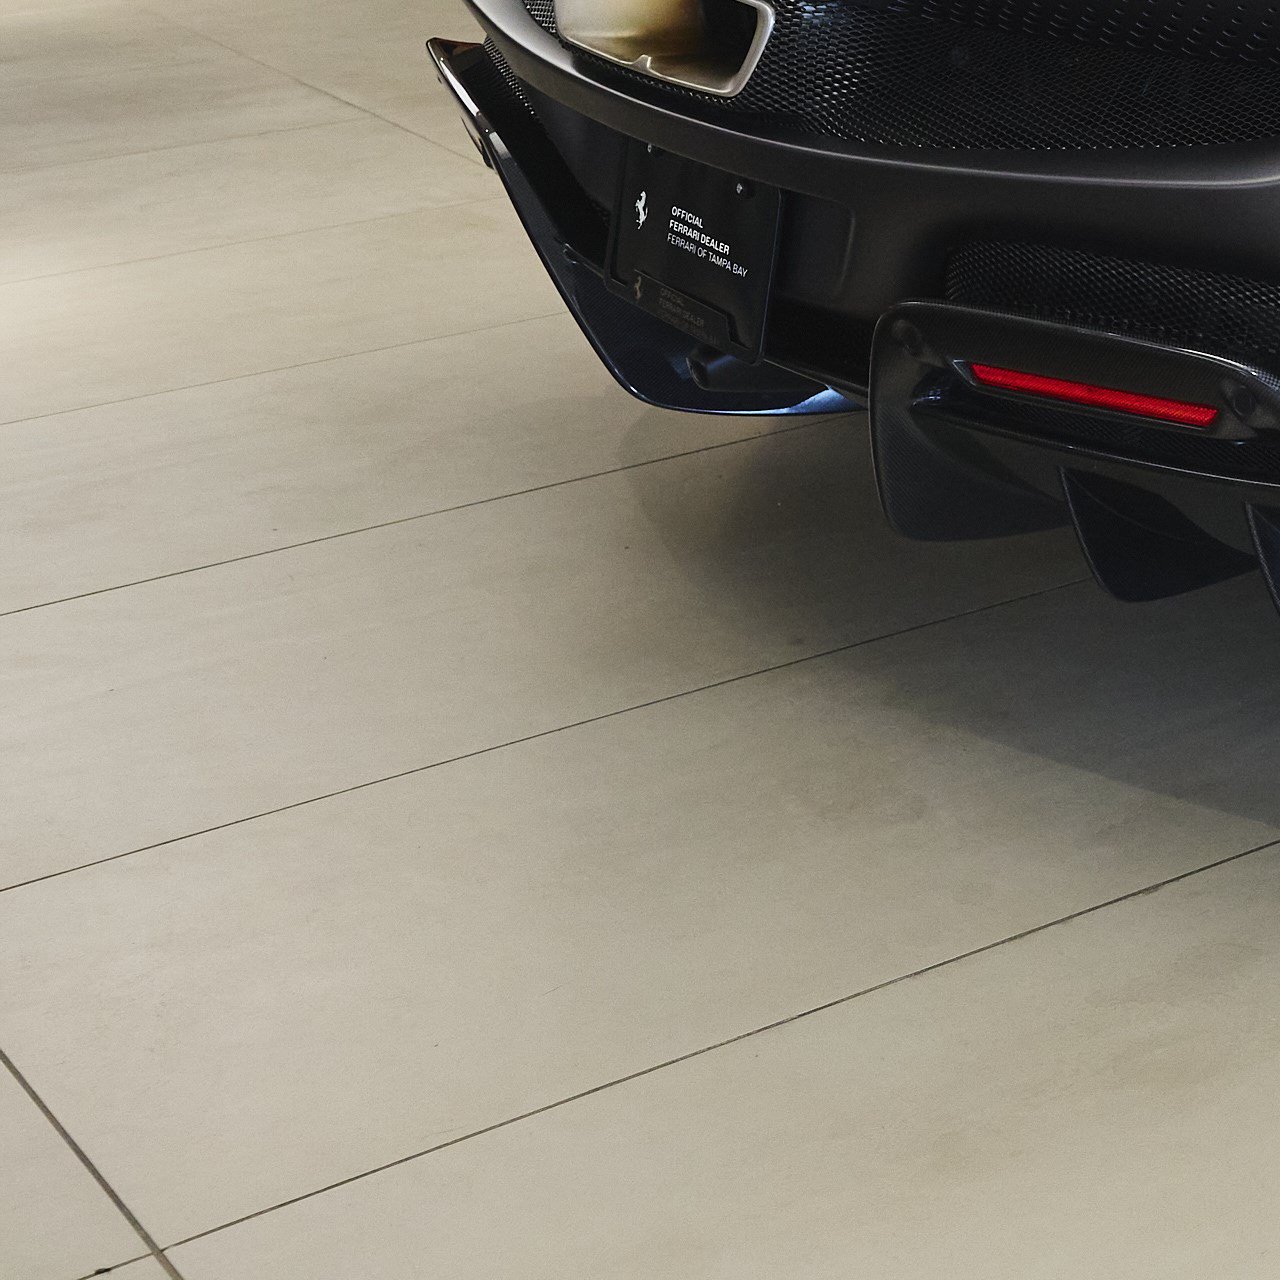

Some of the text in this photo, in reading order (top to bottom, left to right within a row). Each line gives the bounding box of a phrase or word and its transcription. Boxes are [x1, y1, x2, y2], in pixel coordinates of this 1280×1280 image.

[671, 206, 704, 229] OFFICIAL
[667, 232, 748, 278] FERRARI OF TAMPA BAY
[669, 219, 730, 255] FERRARI DEALER
